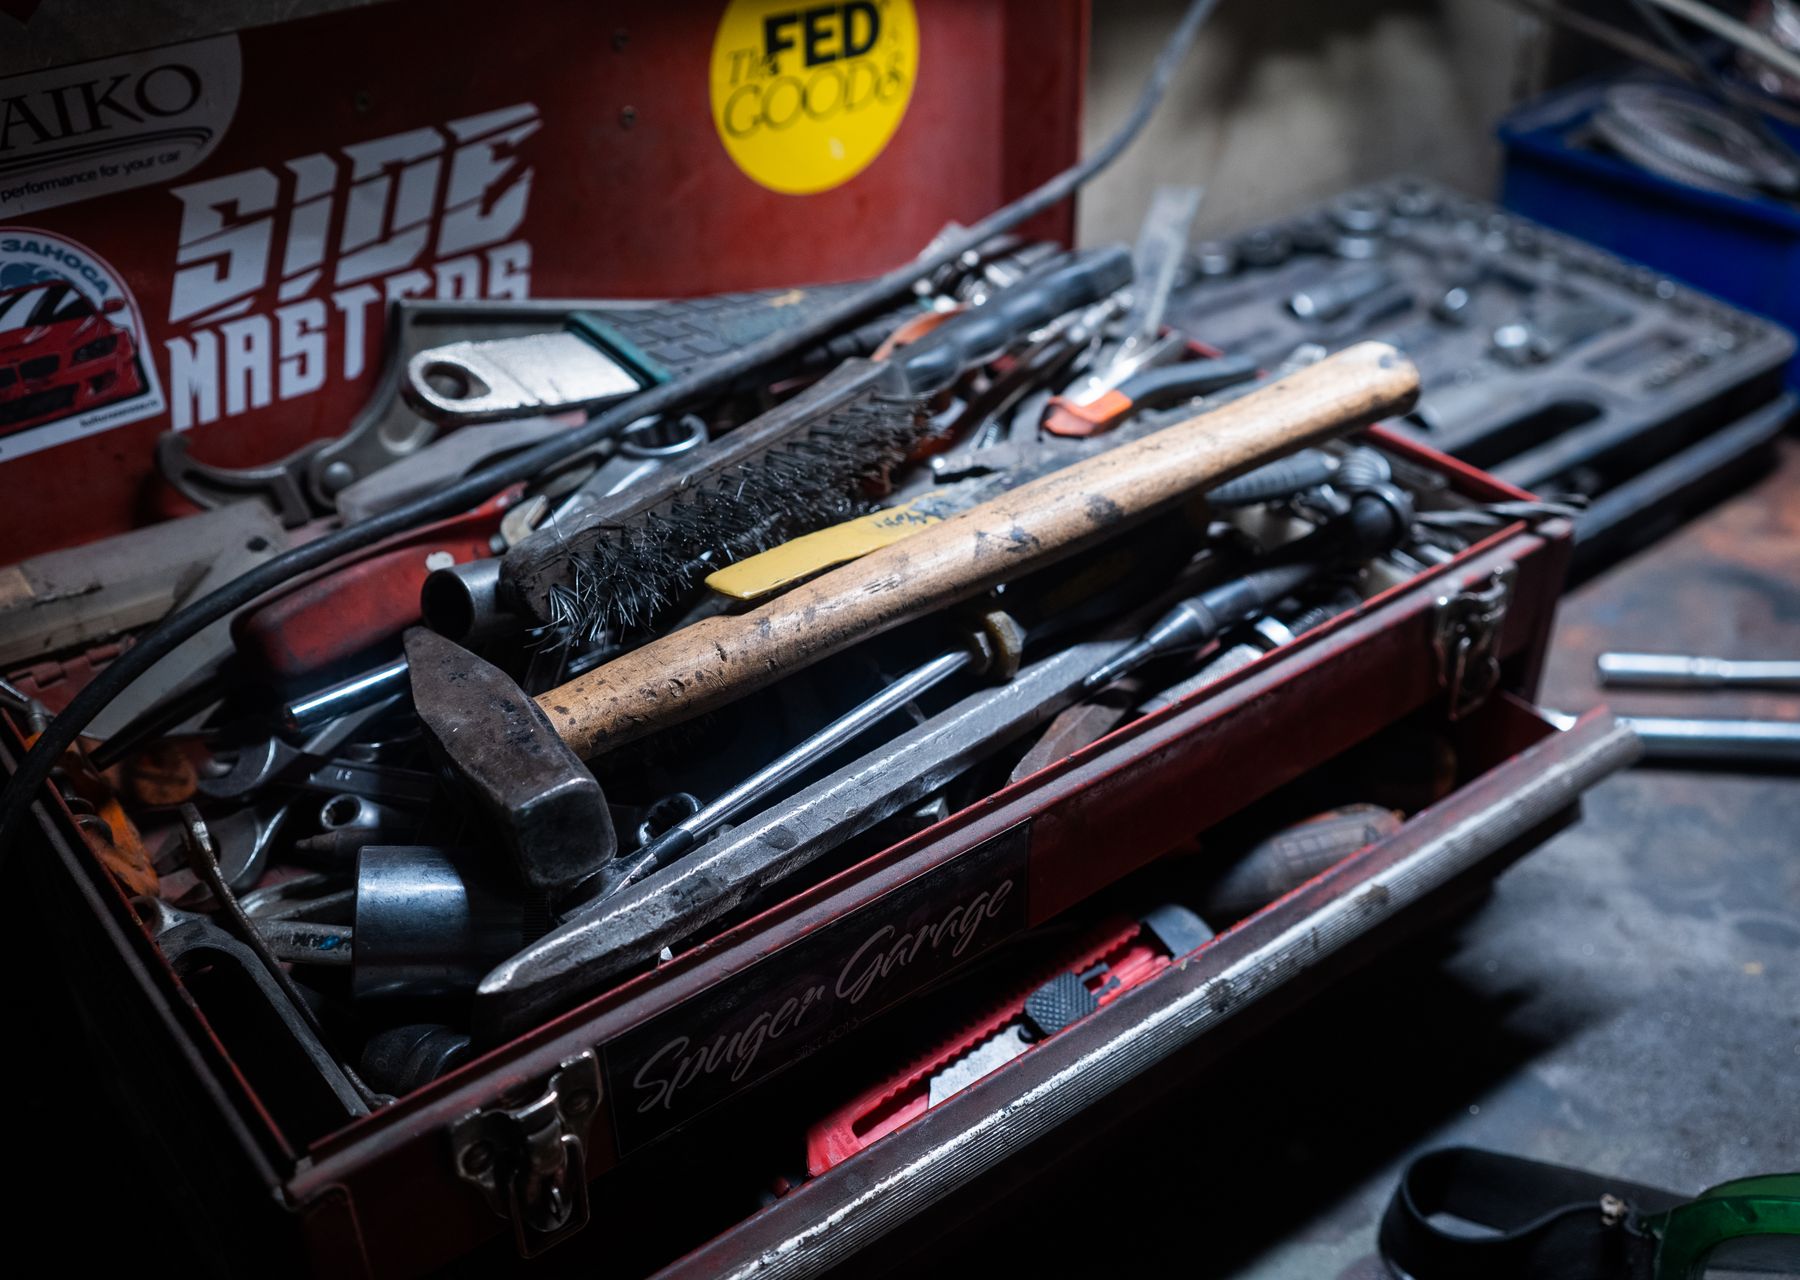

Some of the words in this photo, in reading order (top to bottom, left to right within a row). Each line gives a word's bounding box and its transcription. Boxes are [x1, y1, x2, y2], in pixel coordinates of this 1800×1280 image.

[763, 1, 881, 75] FED
[1, 168, 97, 202] performance
[100, 161, 119, 178] for
[123, 155, 155, 175] your
[159, 151, 181, 165] car
[169, 103, 542, 324] SIDE
[2, 239, 109, 295] ЗАНОСА
[633, 984, 826, 1113] Spuger
[835, 879, 1013, 1004] Garage
